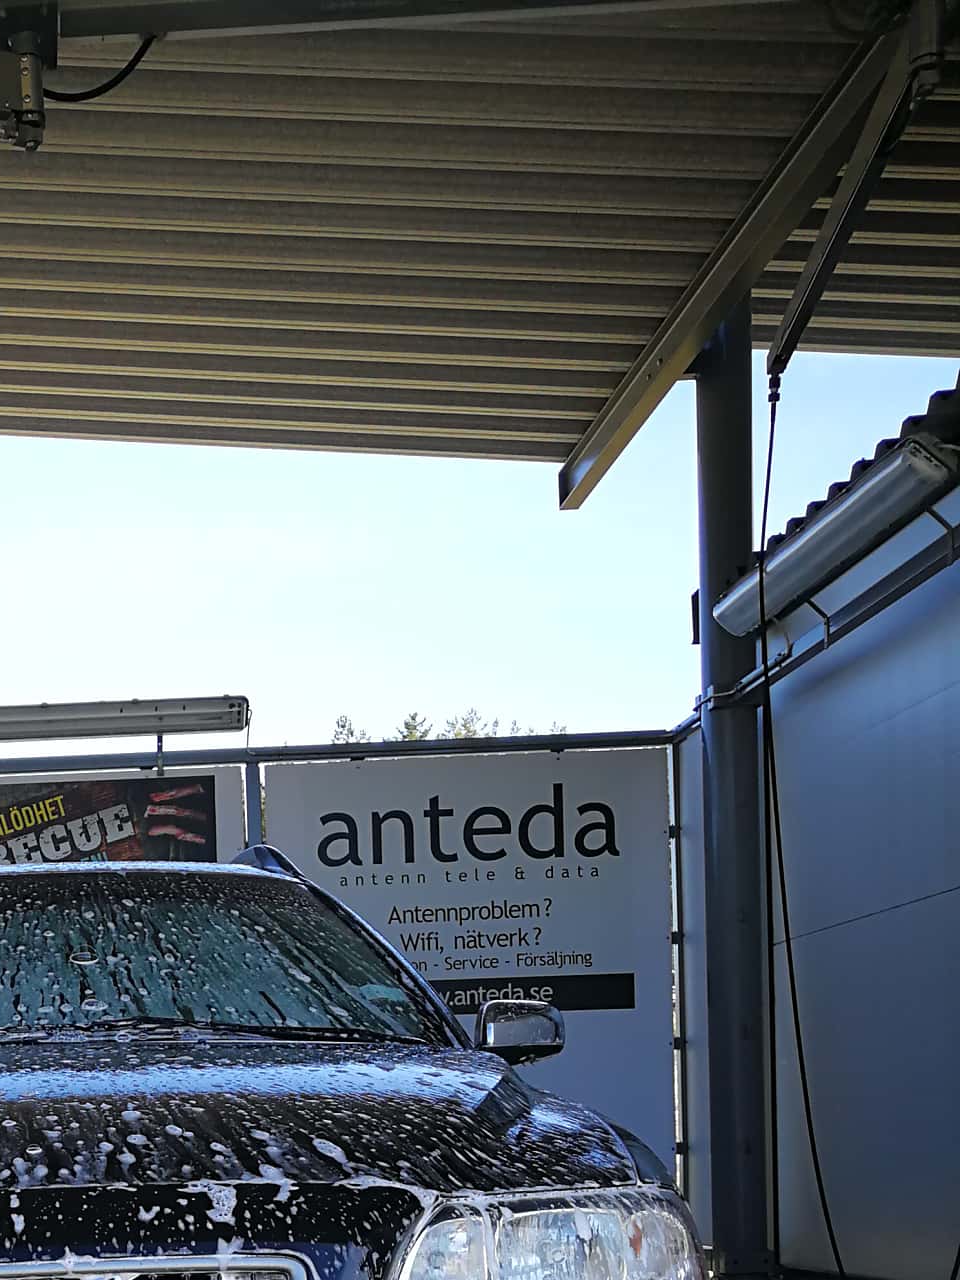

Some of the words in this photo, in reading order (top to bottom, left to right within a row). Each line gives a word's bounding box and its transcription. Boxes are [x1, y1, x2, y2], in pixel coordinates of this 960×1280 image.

[316, 783, 620, 868] anteda
[339, 872, 427, 888] antenn
[445, 868, 497, 883] tele
[514, 866, 526, 880] &
[544, 863, 601, 880] data
[387, 897, 553, 926] Antennproblem?
[399, 932, 445, 954] Wifi,
[444, 955, 500, 971] Service
[515, 950, 594, 969] Försäljning
